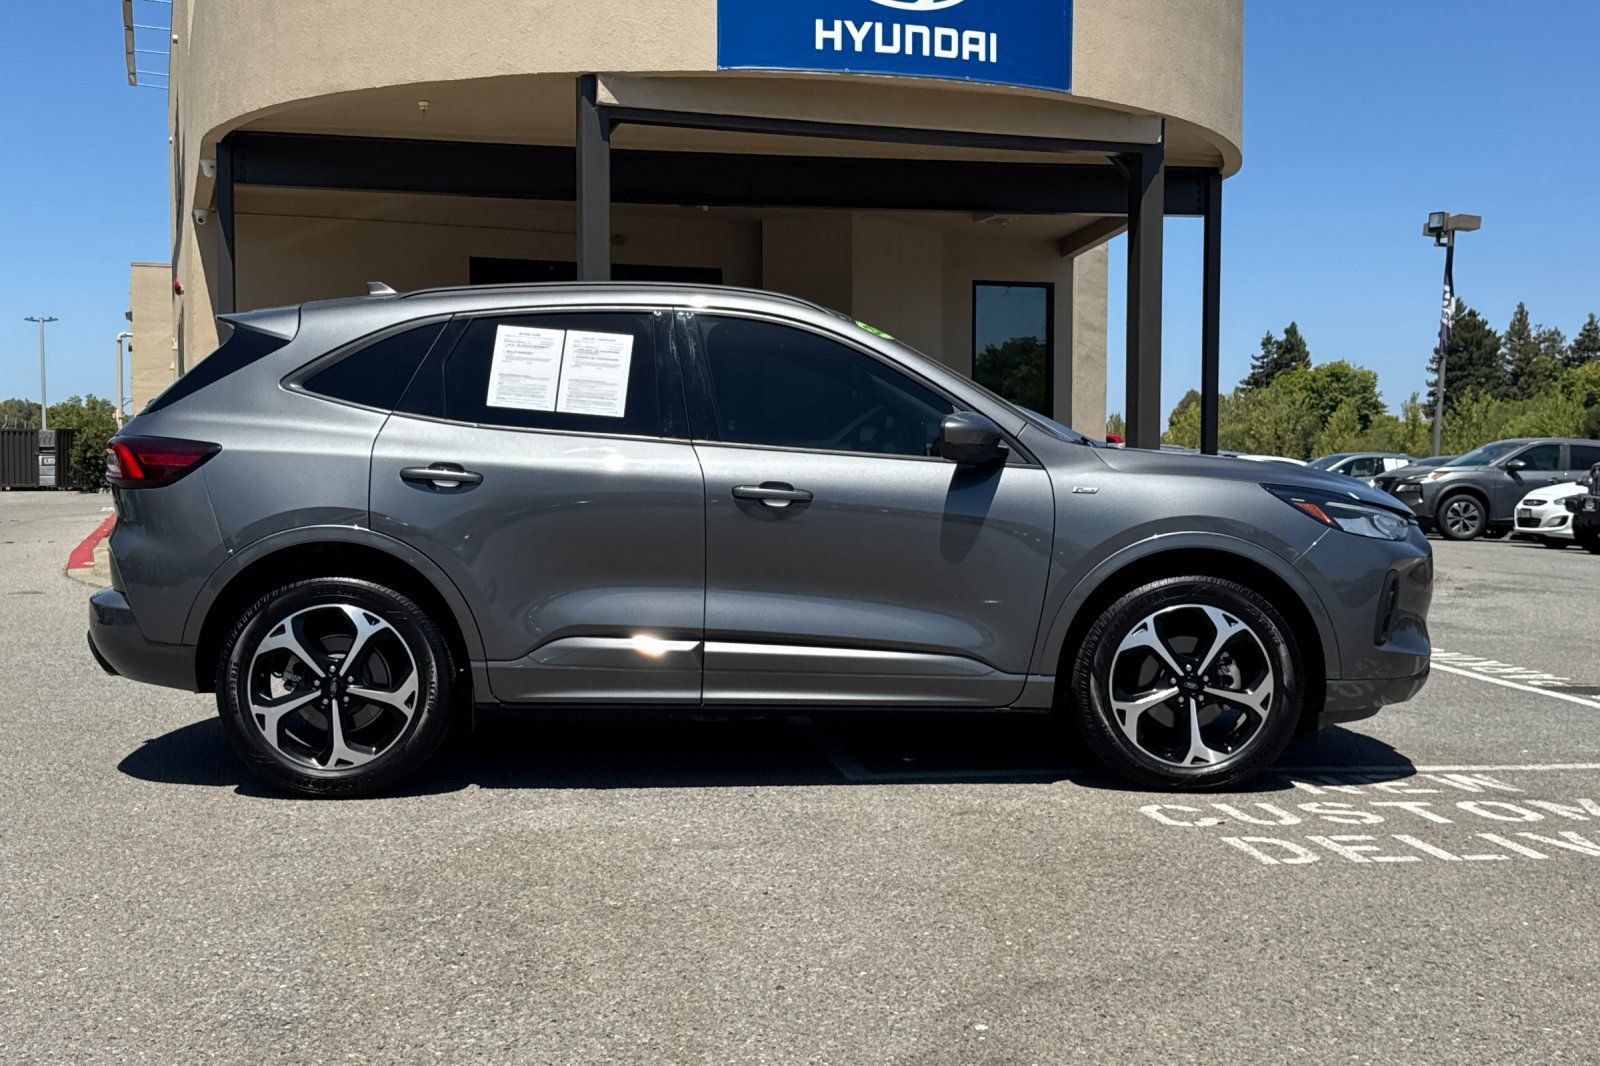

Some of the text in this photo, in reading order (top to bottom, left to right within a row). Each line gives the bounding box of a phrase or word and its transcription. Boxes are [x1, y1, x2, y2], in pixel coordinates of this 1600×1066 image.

[815, 18, 997, 63] HYUNDAI
[1430, 647, 1573, 687] PARKIN
[1221, 831, 1600, 865] DELIV
